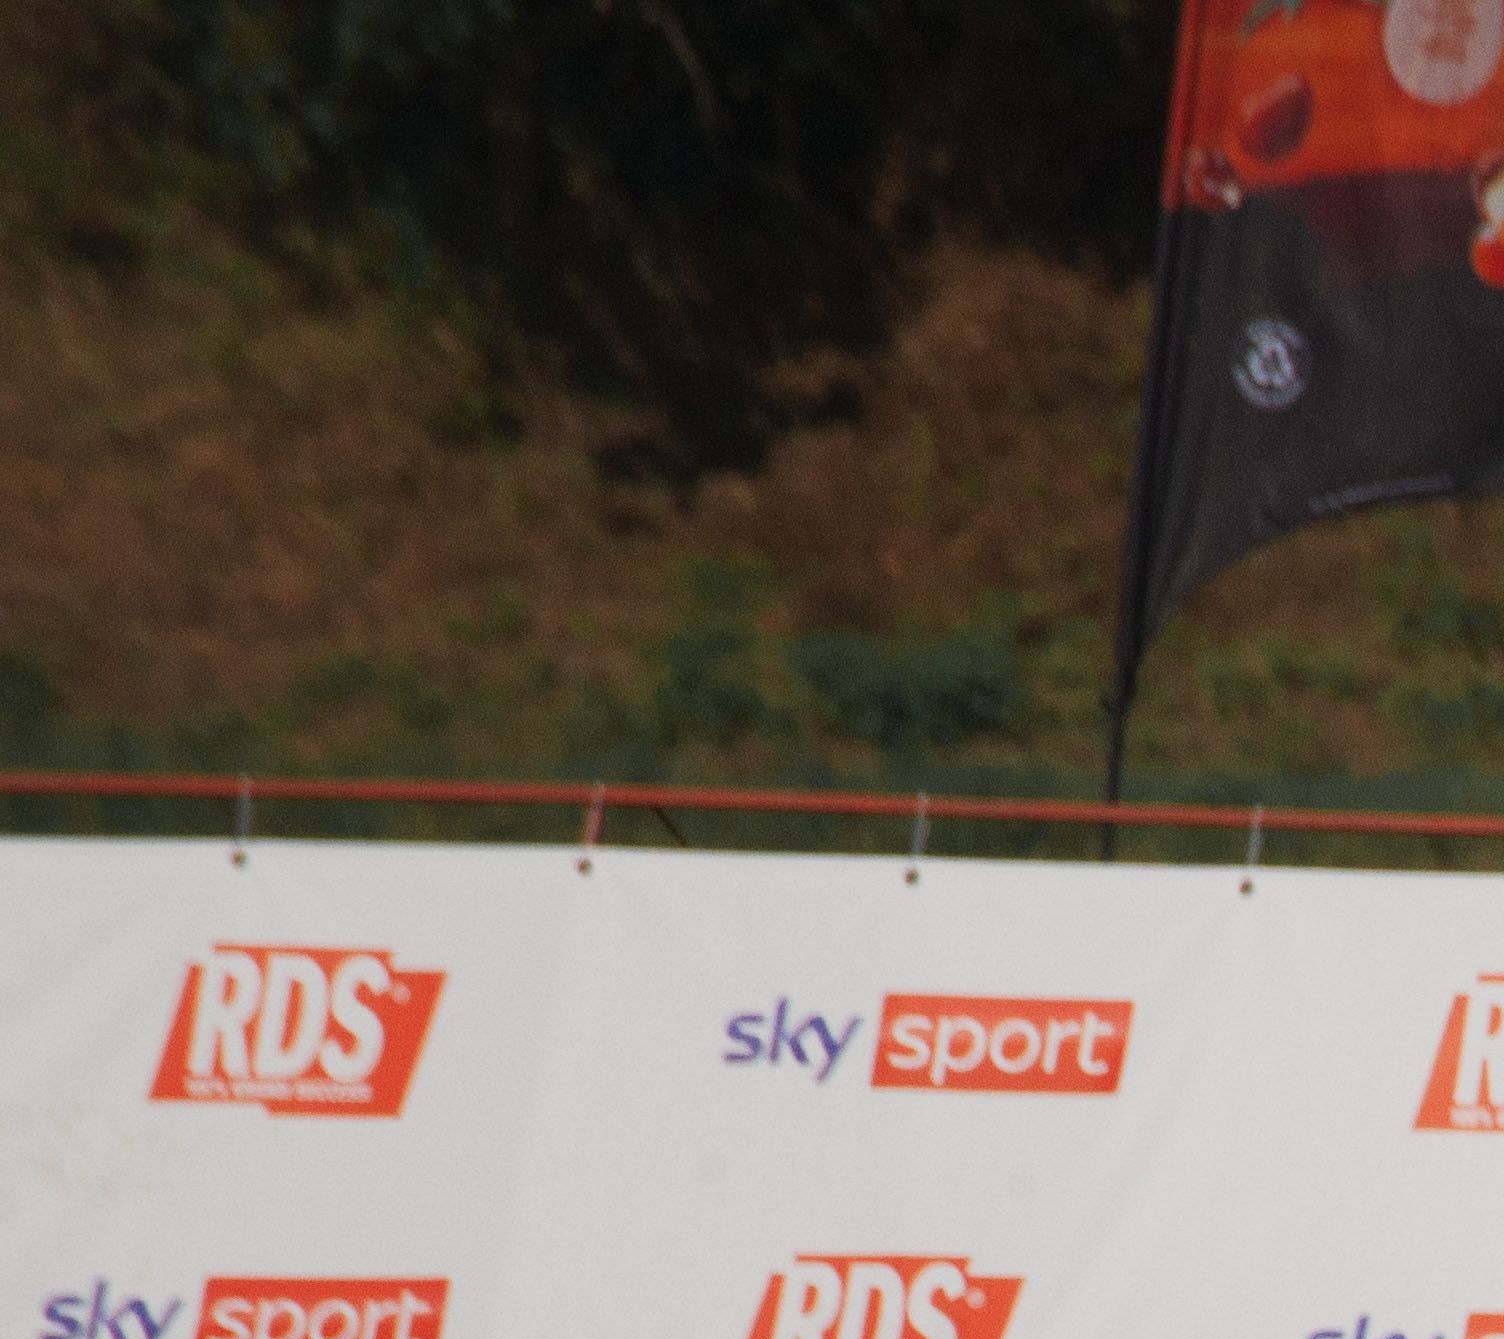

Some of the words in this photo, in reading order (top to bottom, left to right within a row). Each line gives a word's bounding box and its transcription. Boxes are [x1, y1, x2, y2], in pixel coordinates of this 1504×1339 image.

[187, 950, 391, 1081] RDS
[722, 997, 864, 1084] sky
[888, 1010, 1116, 1086] sport
